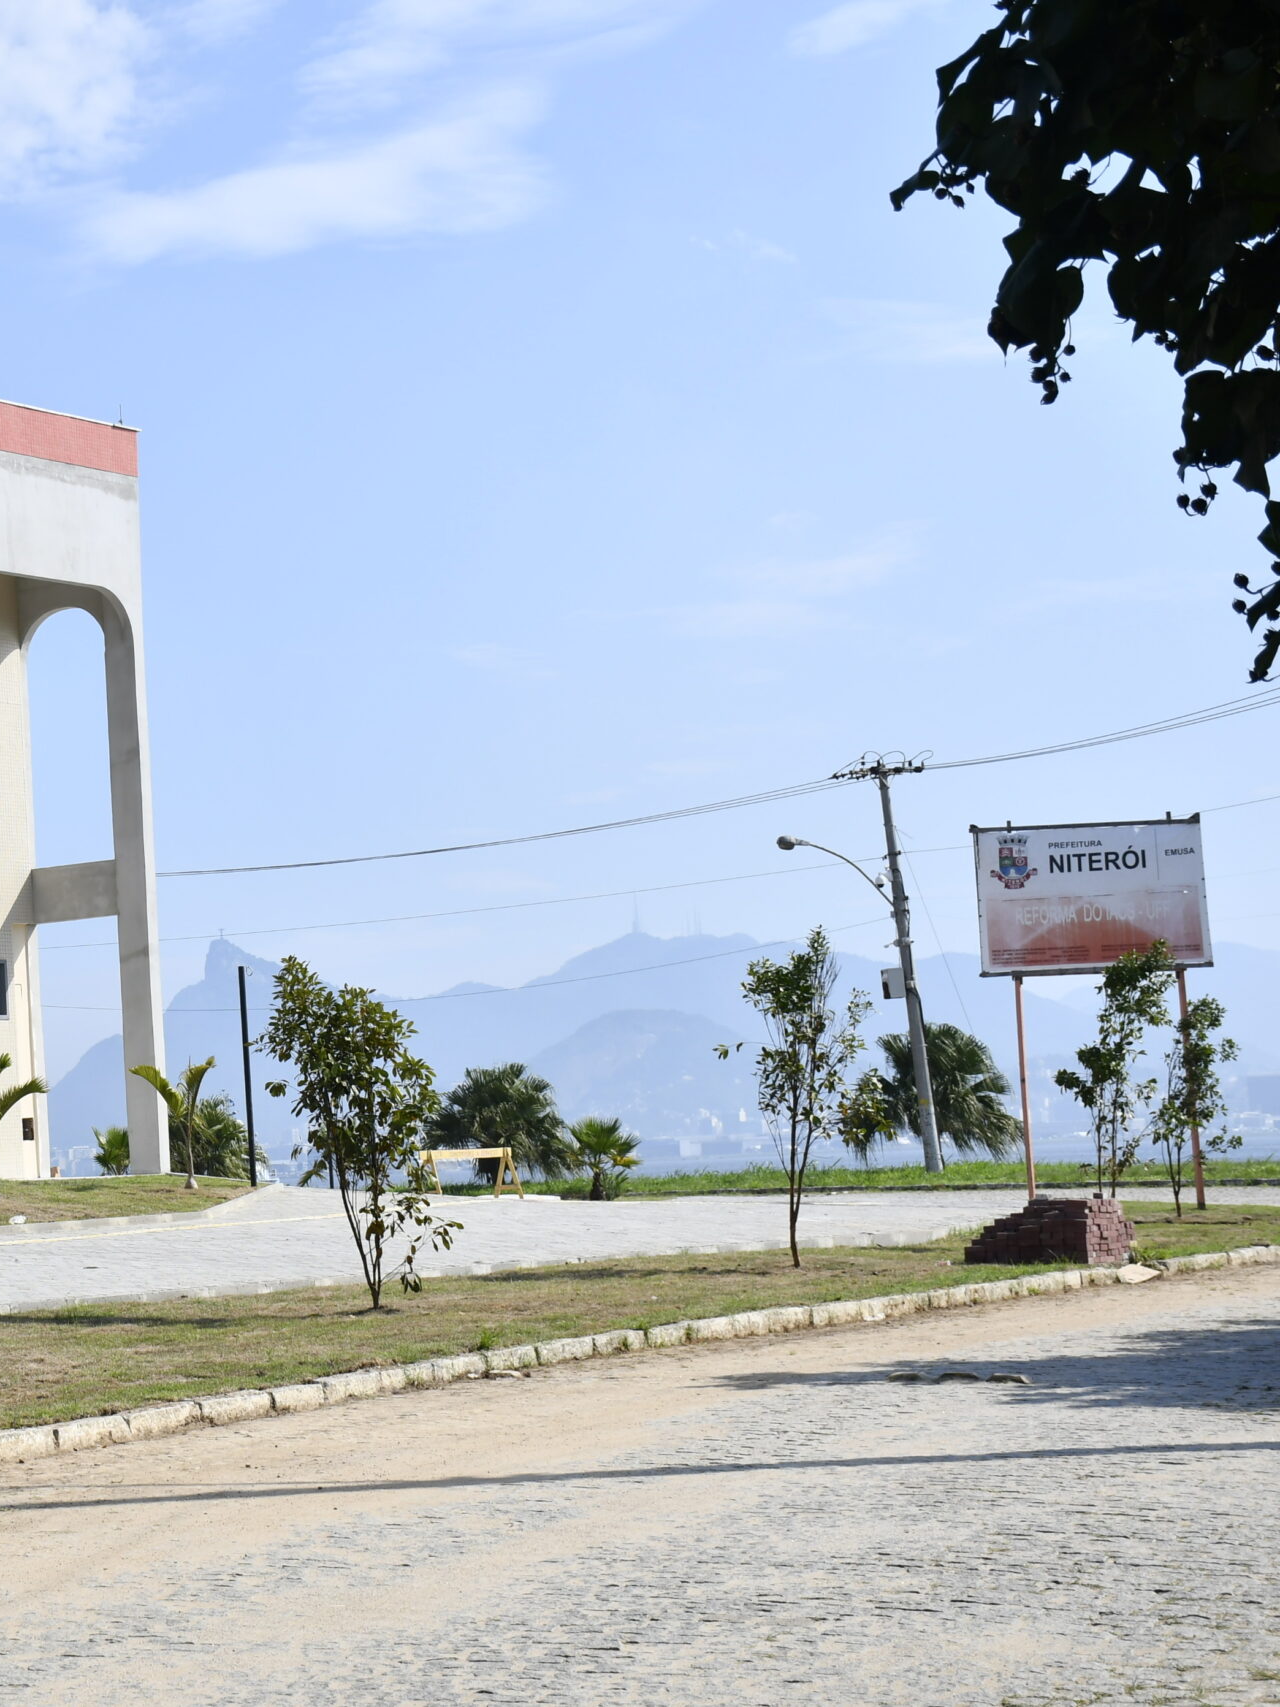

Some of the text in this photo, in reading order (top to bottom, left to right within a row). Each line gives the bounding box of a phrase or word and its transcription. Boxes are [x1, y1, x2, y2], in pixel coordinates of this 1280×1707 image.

[1048, 840, 1103, 849] PREFEITURA
[1164, 847, 1196, 857] EMUSA
[1048, 845, 1147, 874] NITERÓI
[1083, 903, 1102, 922] DO
